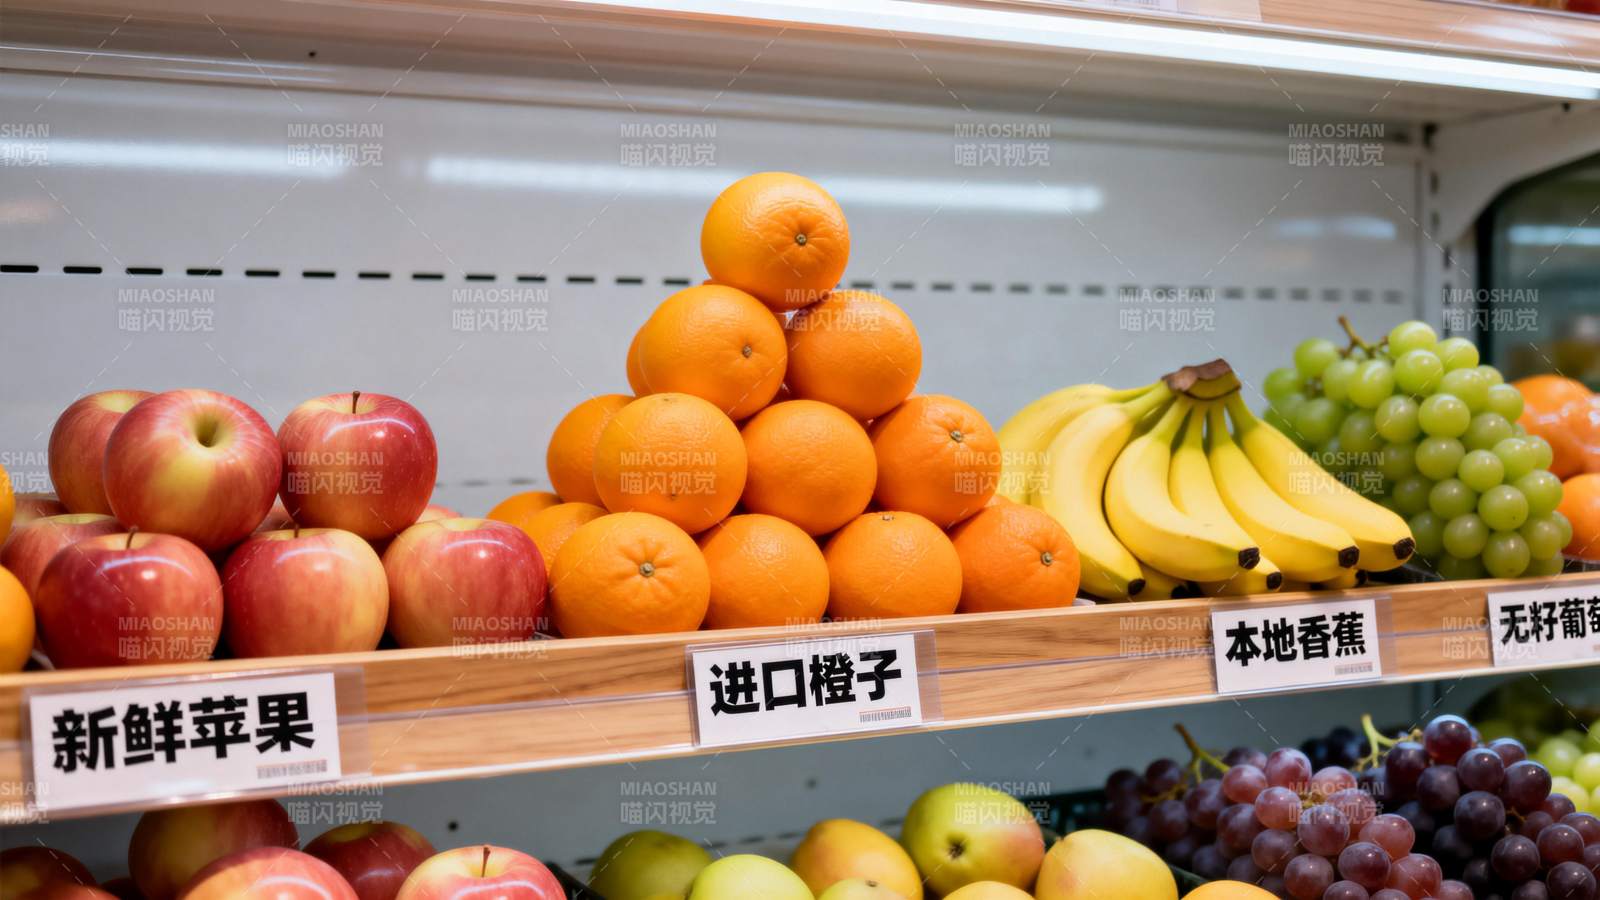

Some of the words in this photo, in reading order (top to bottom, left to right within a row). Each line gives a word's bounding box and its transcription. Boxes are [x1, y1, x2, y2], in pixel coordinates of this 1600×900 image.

[1225, 611, 1366, 666] 本地香蕉
[710, 650, 901, 716] 进口橙子
[52, 692, 314, 773] 新鲜苹果
